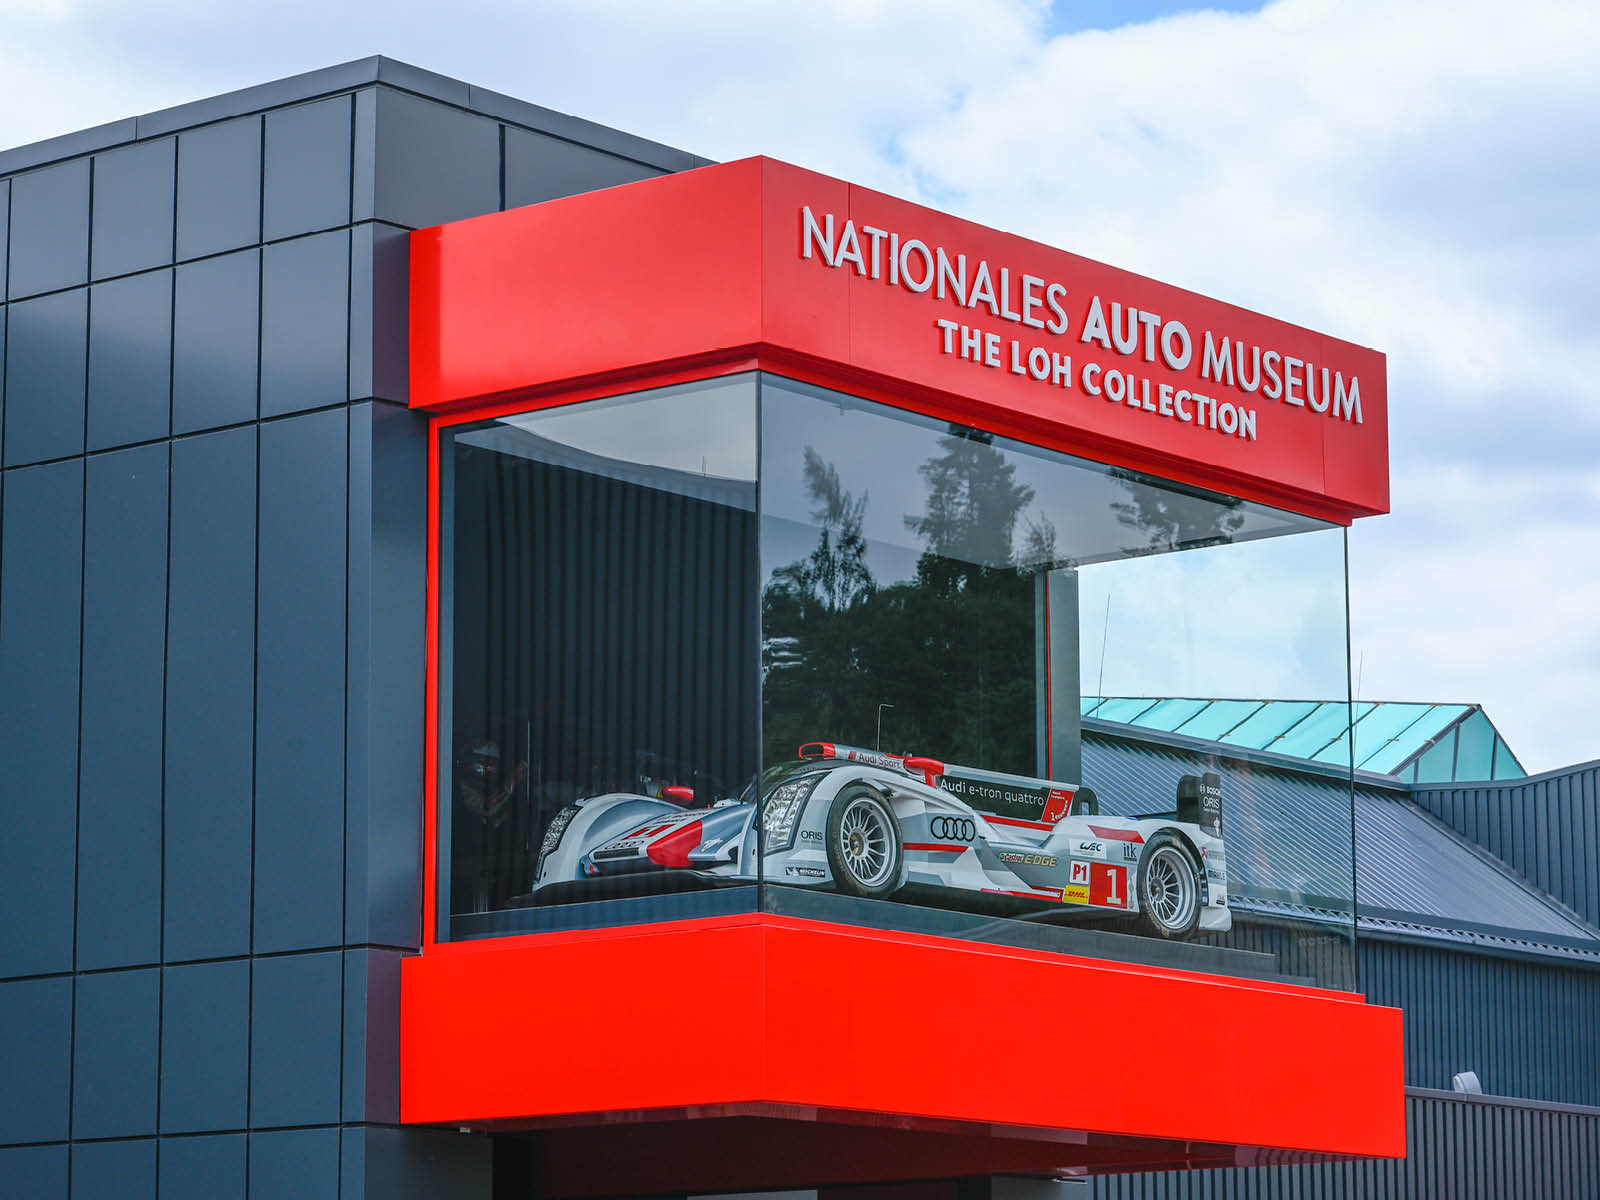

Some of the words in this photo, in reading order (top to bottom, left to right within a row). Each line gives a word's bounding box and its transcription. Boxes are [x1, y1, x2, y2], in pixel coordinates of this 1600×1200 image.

[801, 205, 1069, 335] NATIONALES
[1080, 295, 1193, 371] AUTO
[1201, 330, 1364, 424] MUSEUM
[937, 318, 1001, 368] THE
[1010, 340, 1072, 388] LOH
[1081, 363, 1257, 441] COLLECTION
[858, 752, 876, 764] Audi
[879, 756, 901, 769] Sport
[940, 778, 967, 794] Audi
[968, 786, 1002, 799] e-tron
[1004, 791, 1045, 806] quattro
[1203, 796, 1219, 808] ORIS
[800, 830, 823, 841] ORIS
[1080, 842, 1102, 852] WEC
[1123, 843, 1137, 857] itk
[1024, 854, 1057, 867] EDGE
[1073, 864, 1087, 880] P1
[1106, 869, 1122, 905] 1
